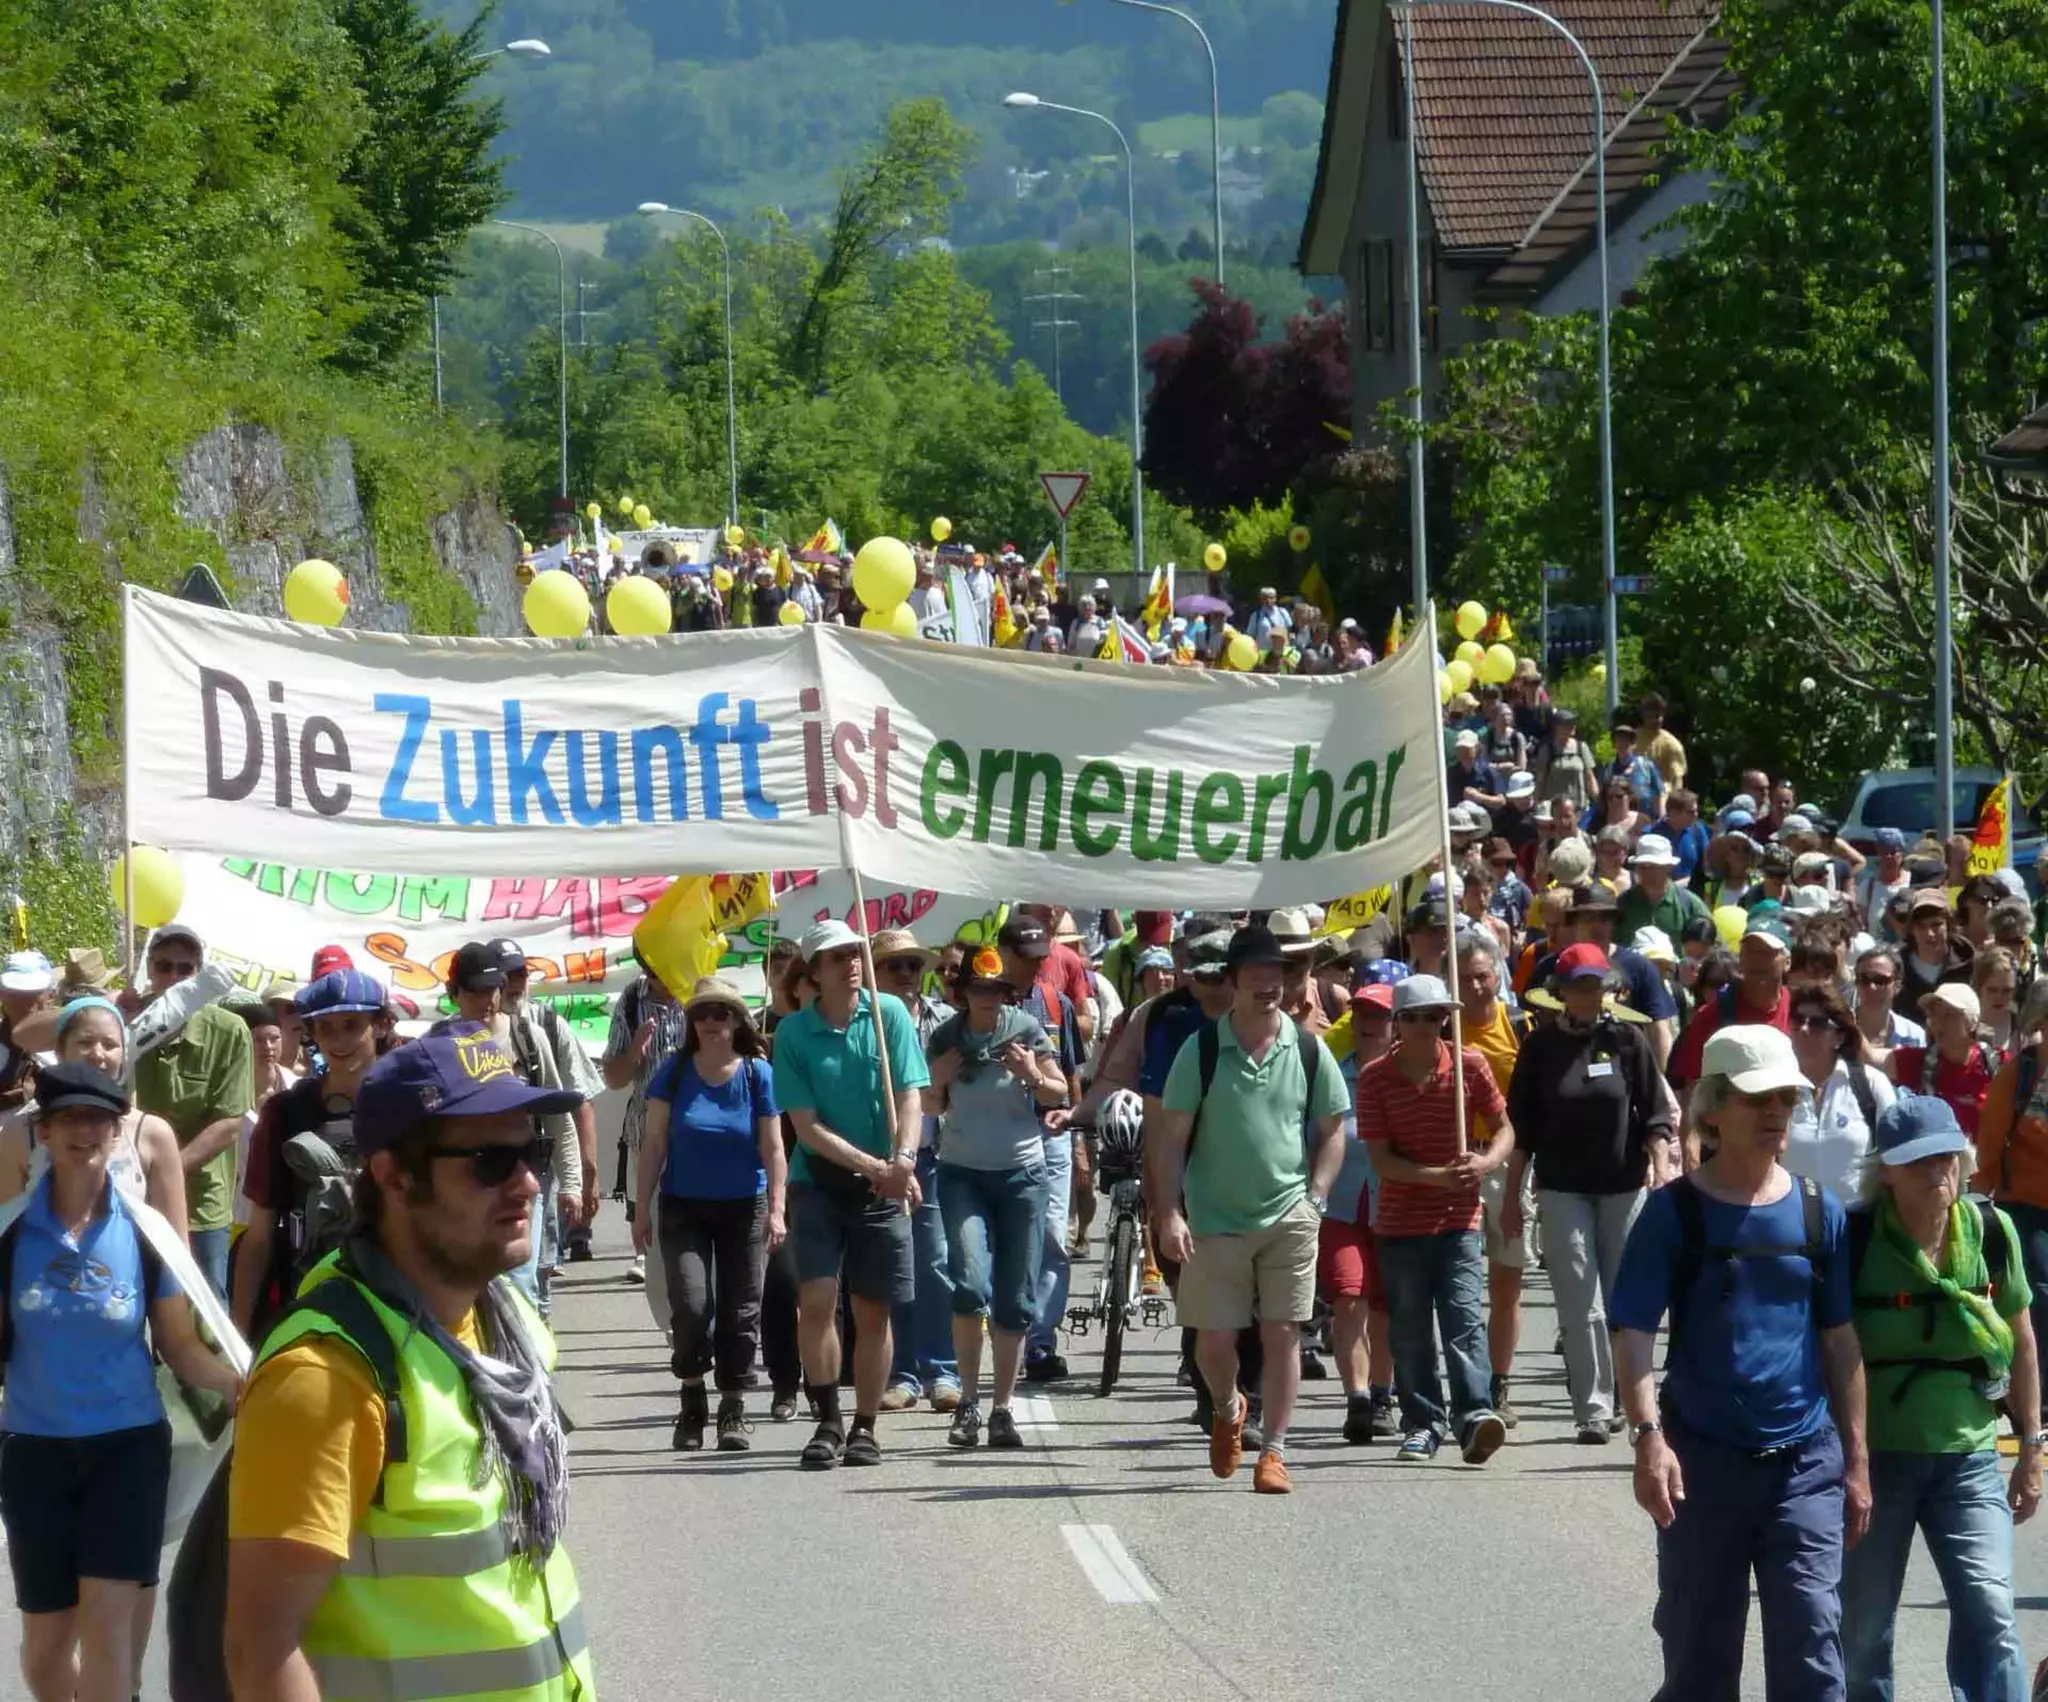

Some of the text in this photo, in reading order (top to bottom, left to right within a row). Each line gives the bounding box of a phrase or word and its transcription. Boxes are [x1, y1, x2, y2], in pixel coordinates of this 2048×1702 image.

[200, 665, 1406, 864] Die Zukunft ist erneuerbar
